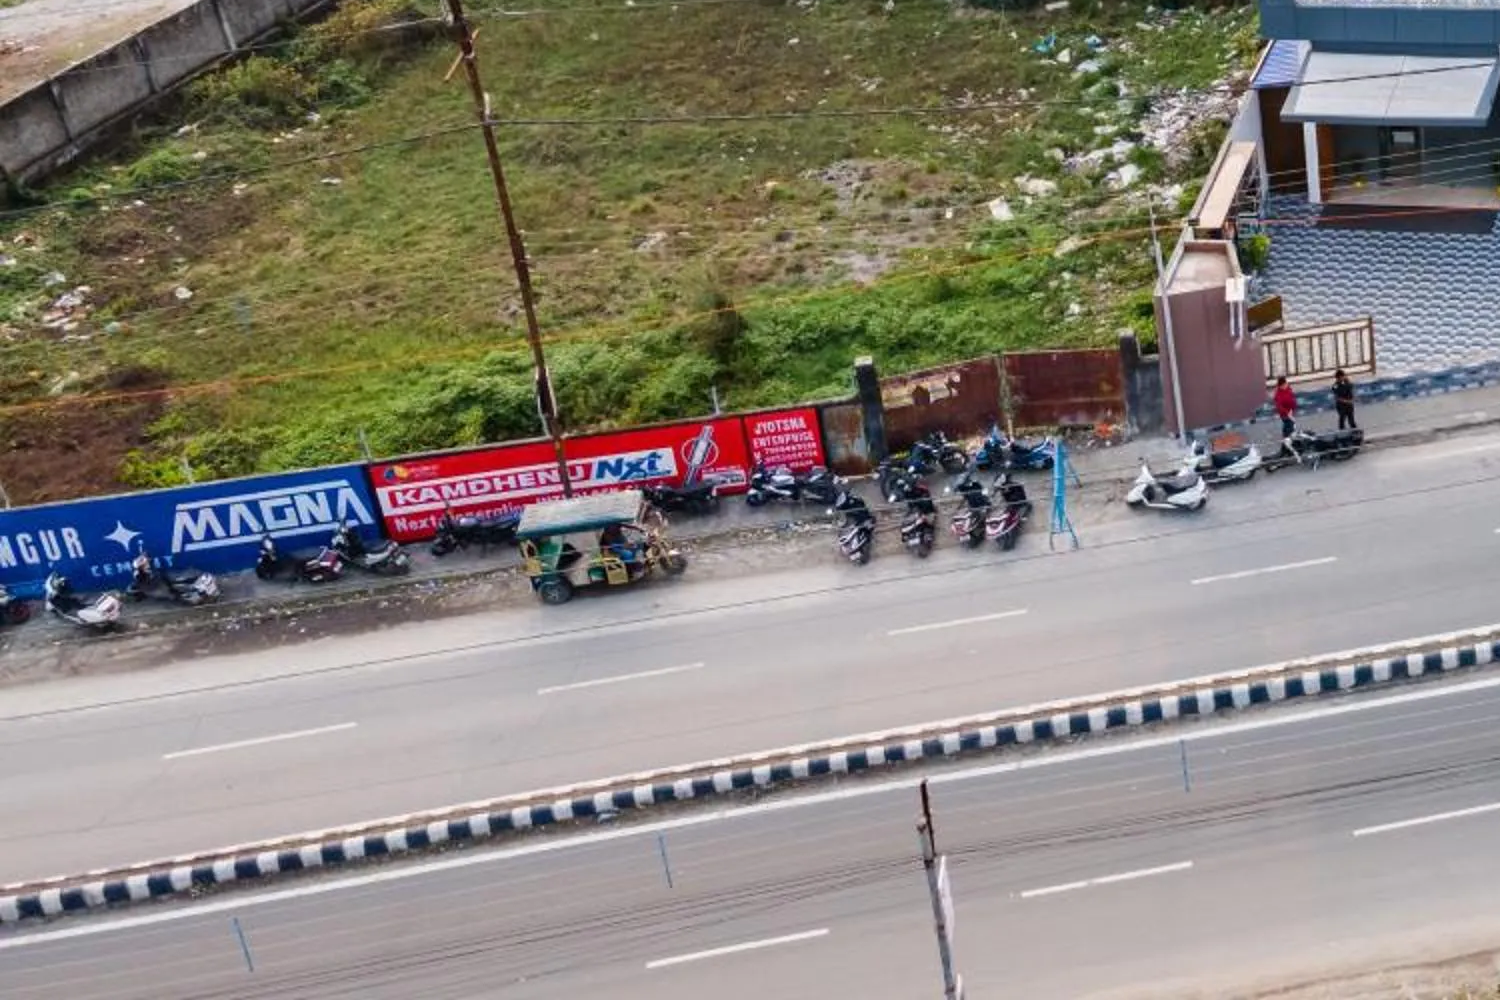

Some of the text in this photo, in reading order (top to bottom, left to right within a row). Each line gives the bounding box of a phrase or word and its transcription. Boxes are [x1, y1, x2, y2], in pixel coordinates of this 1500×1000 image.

[394, 464, 584, 506] KAMDHENU
[595, 450, 674, 481] Nxt
[172, 486, 376, 554] MAGNA
